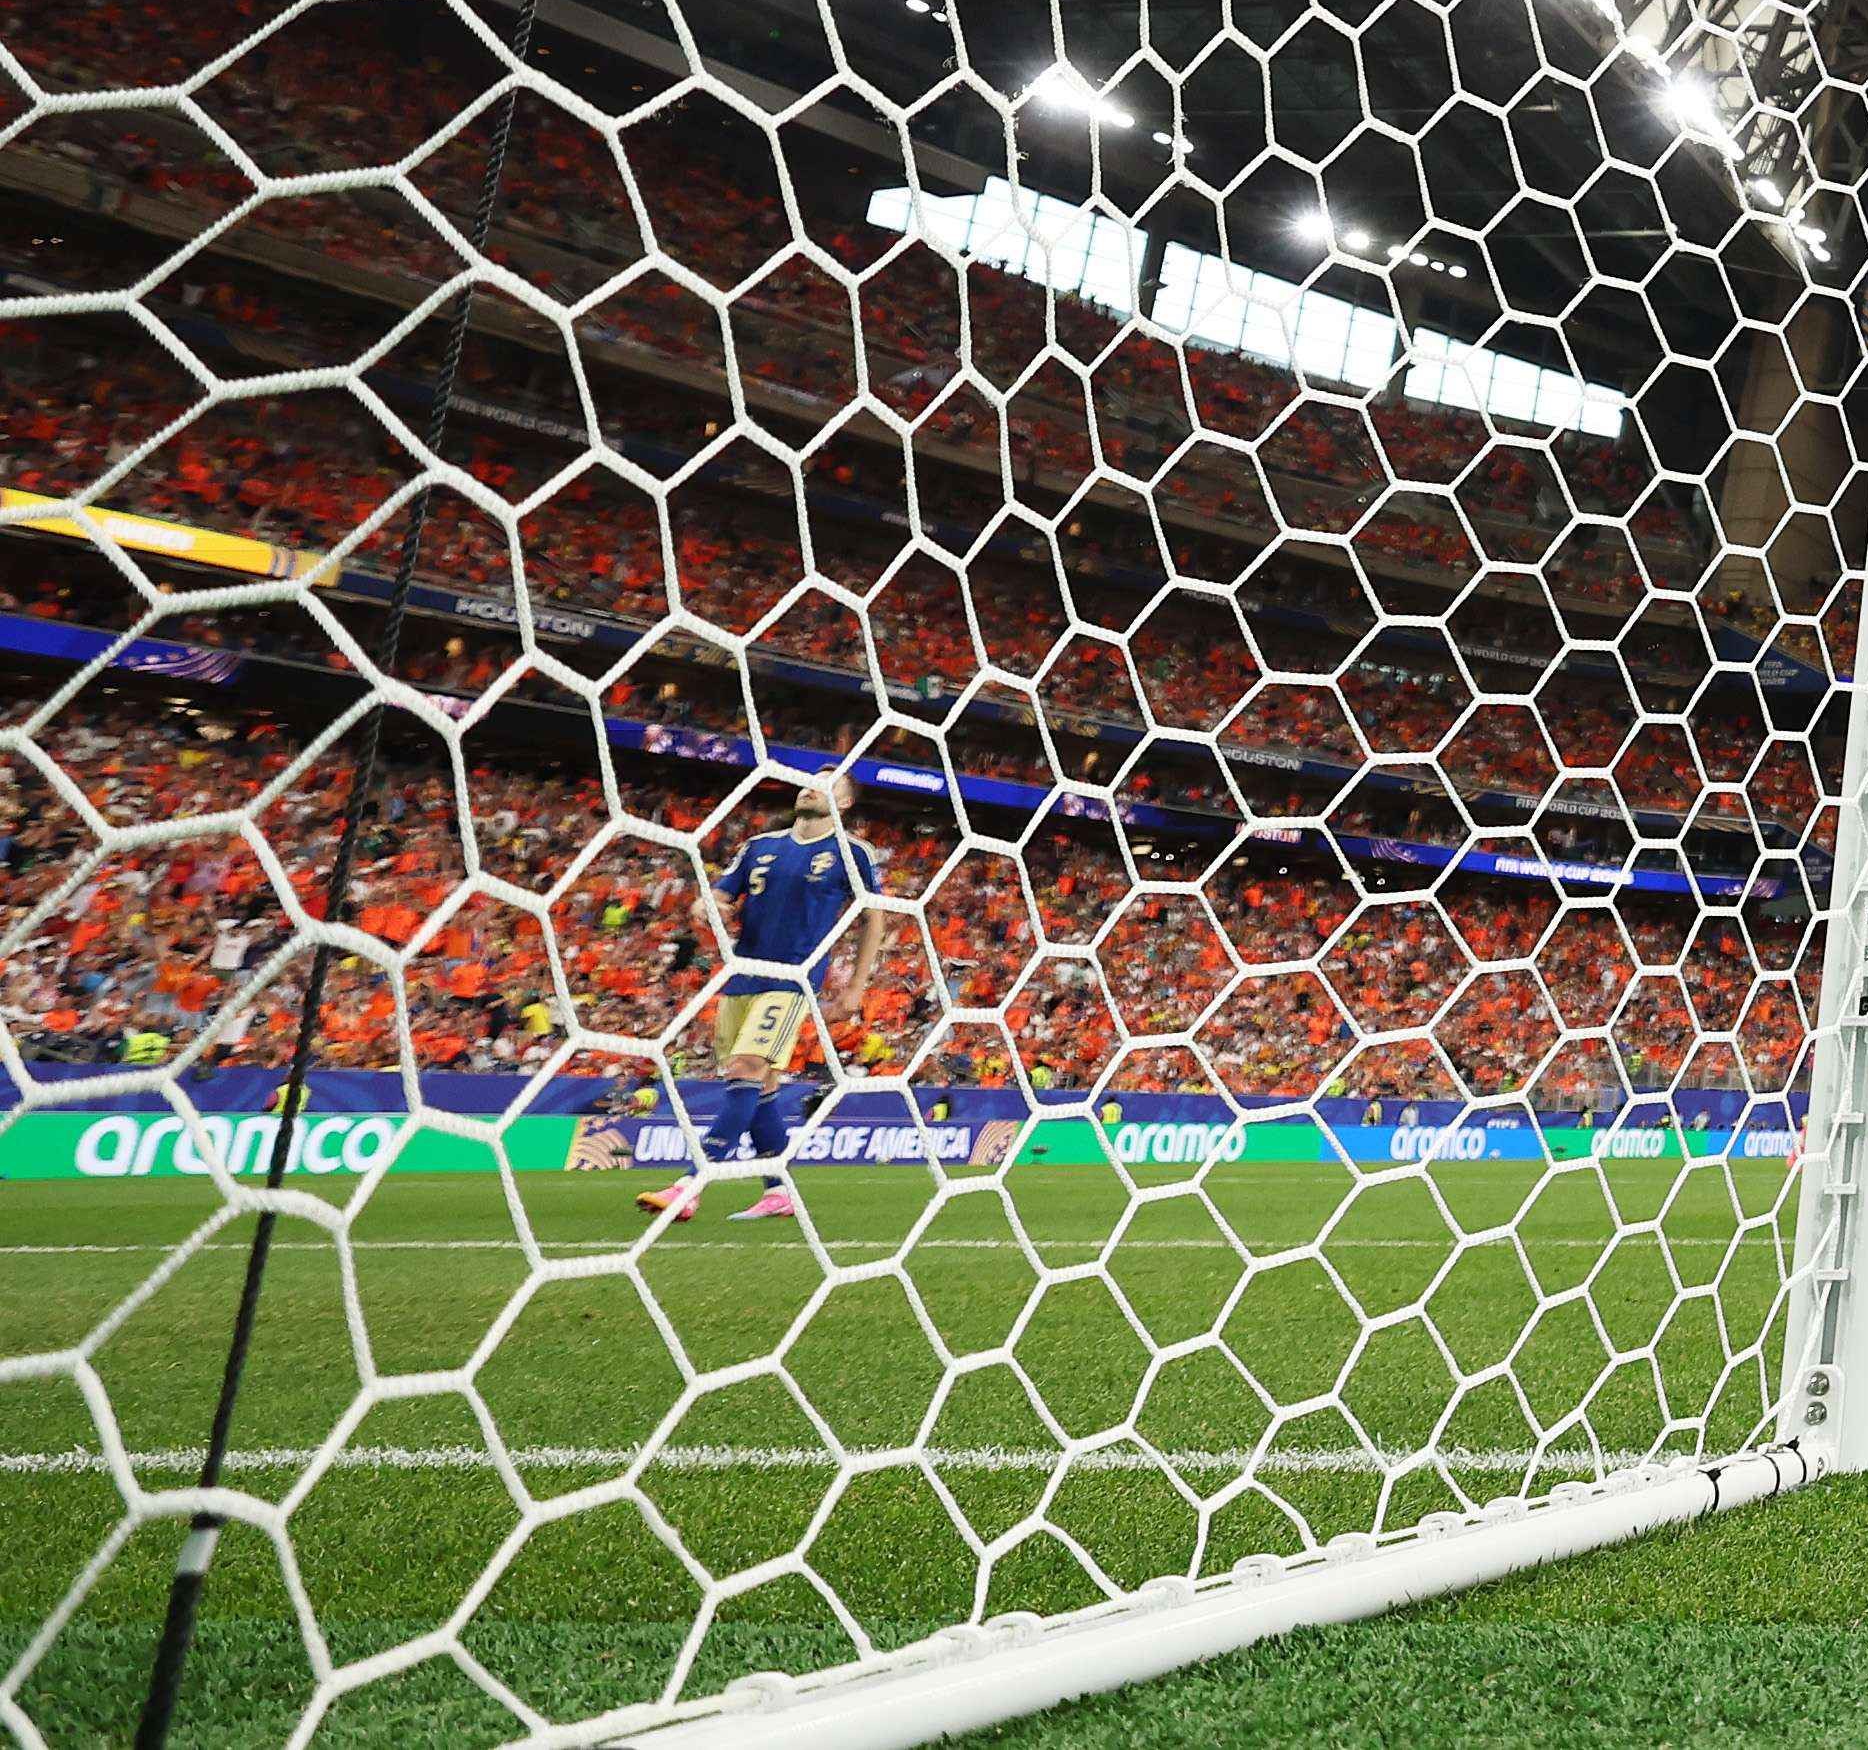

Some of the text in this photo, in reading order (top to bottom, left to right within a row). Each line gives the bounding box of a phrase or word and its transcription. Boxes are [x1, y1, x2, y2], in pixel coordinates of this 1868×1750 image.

[454, 599, 597, 638] HOUTON
[1543, 801, 1577, 815] ORLD
[750, 866, 770, 896] 5
[1564, 865, 1590, 880] CUP
[758, 1004, 781, 1030] 5
[74, 1115, 399, 1176] aramco
[832, 1126, 871, 1160] OF
[1114, 1123, 1248, 1163] aramco
[1390, 1125, 1487, 1161] aramco
[1590, 1128, 1666, 1158] aramco
